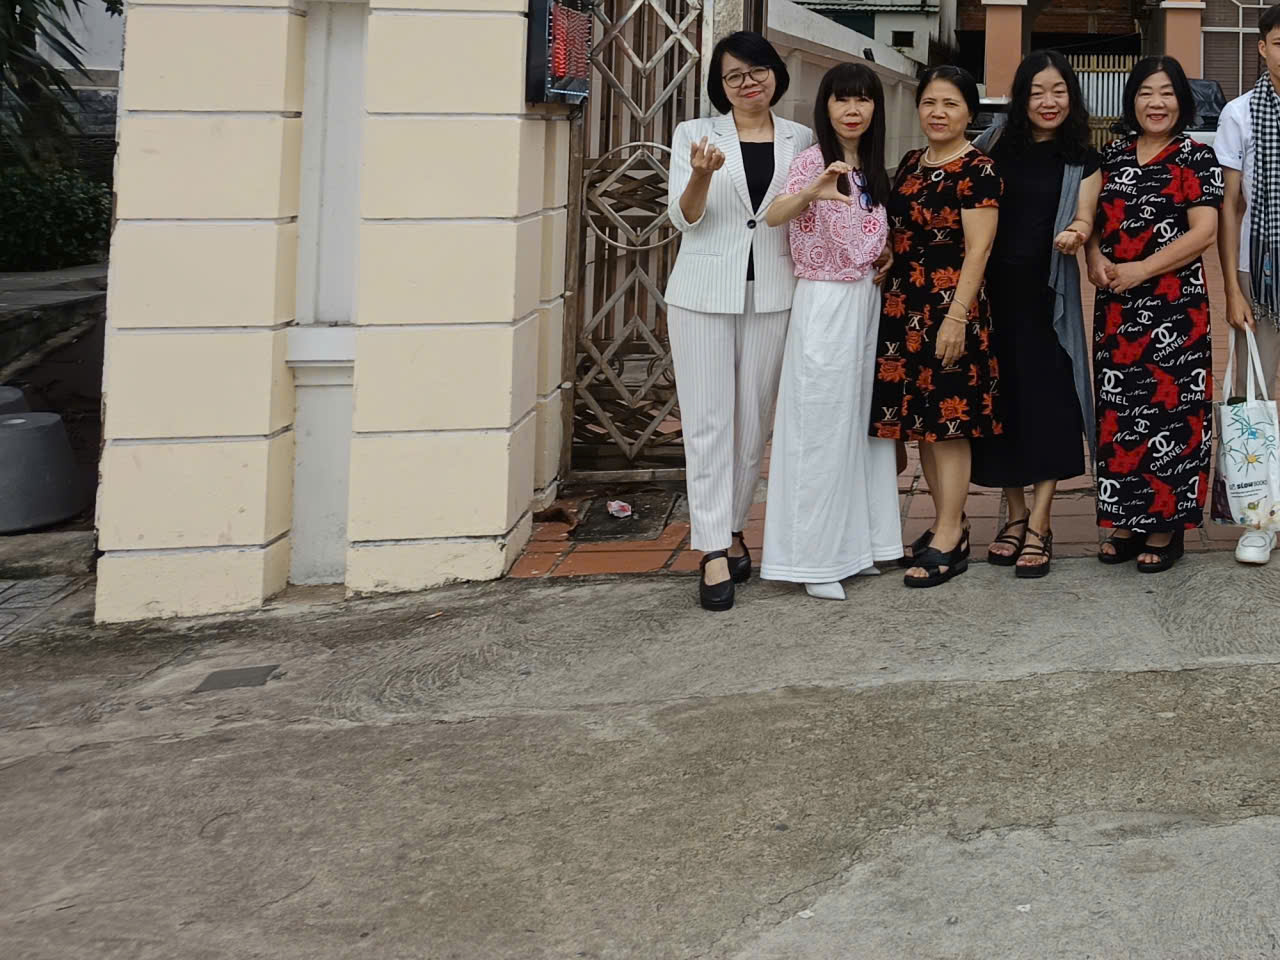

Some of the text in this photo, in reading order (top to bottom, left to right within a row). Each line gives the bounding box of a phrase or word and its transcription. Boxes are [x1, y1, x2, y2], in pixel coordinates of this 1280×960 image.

[1104, 183, 1138, 195] CHANEL
[1153, 335, 1188, 361] CHANEL
[1150, 442, 1187, 471] CHANEL
